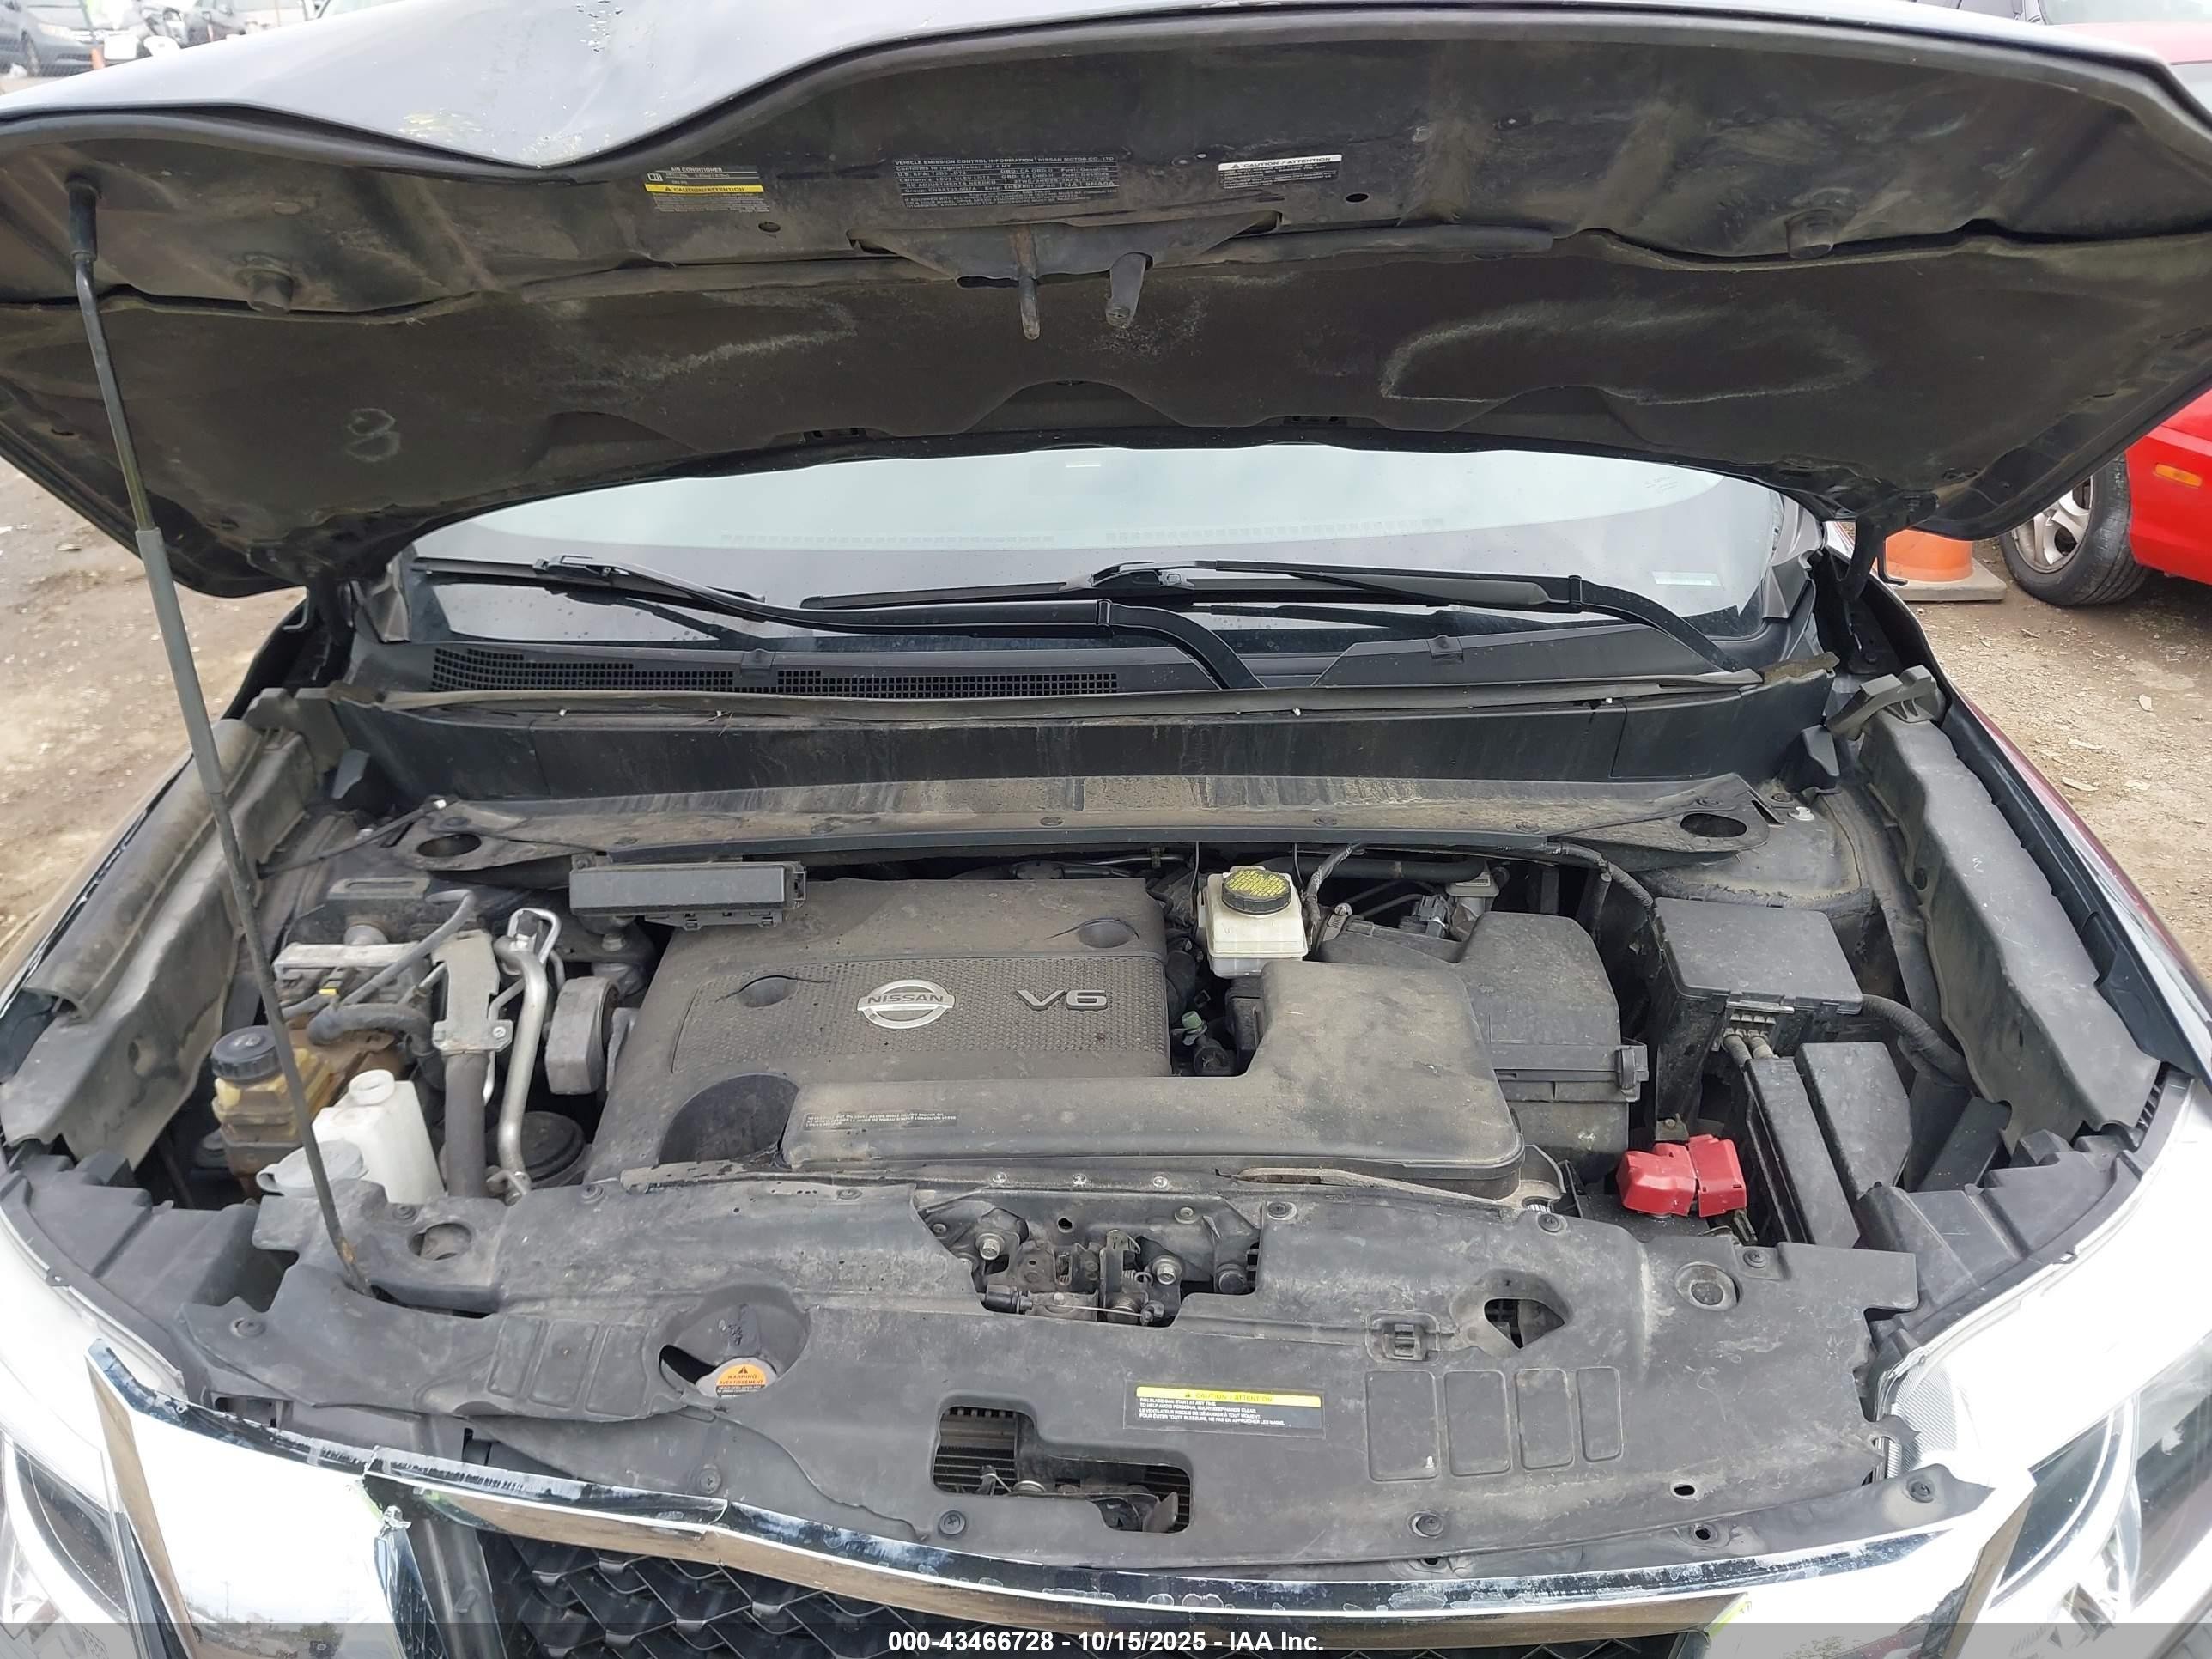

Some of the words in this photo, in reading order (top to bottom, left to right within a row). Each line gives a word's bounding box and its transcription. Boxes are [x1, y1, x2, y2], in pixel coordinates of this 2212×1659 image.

[866, 993, 944, 1005] NISSAN
[1015, 989, 1109, 1011] V6
[1195, 1392, 1227, 1401] CAUTION
[1234, 1394, 1273, 1402] ATTENTION
